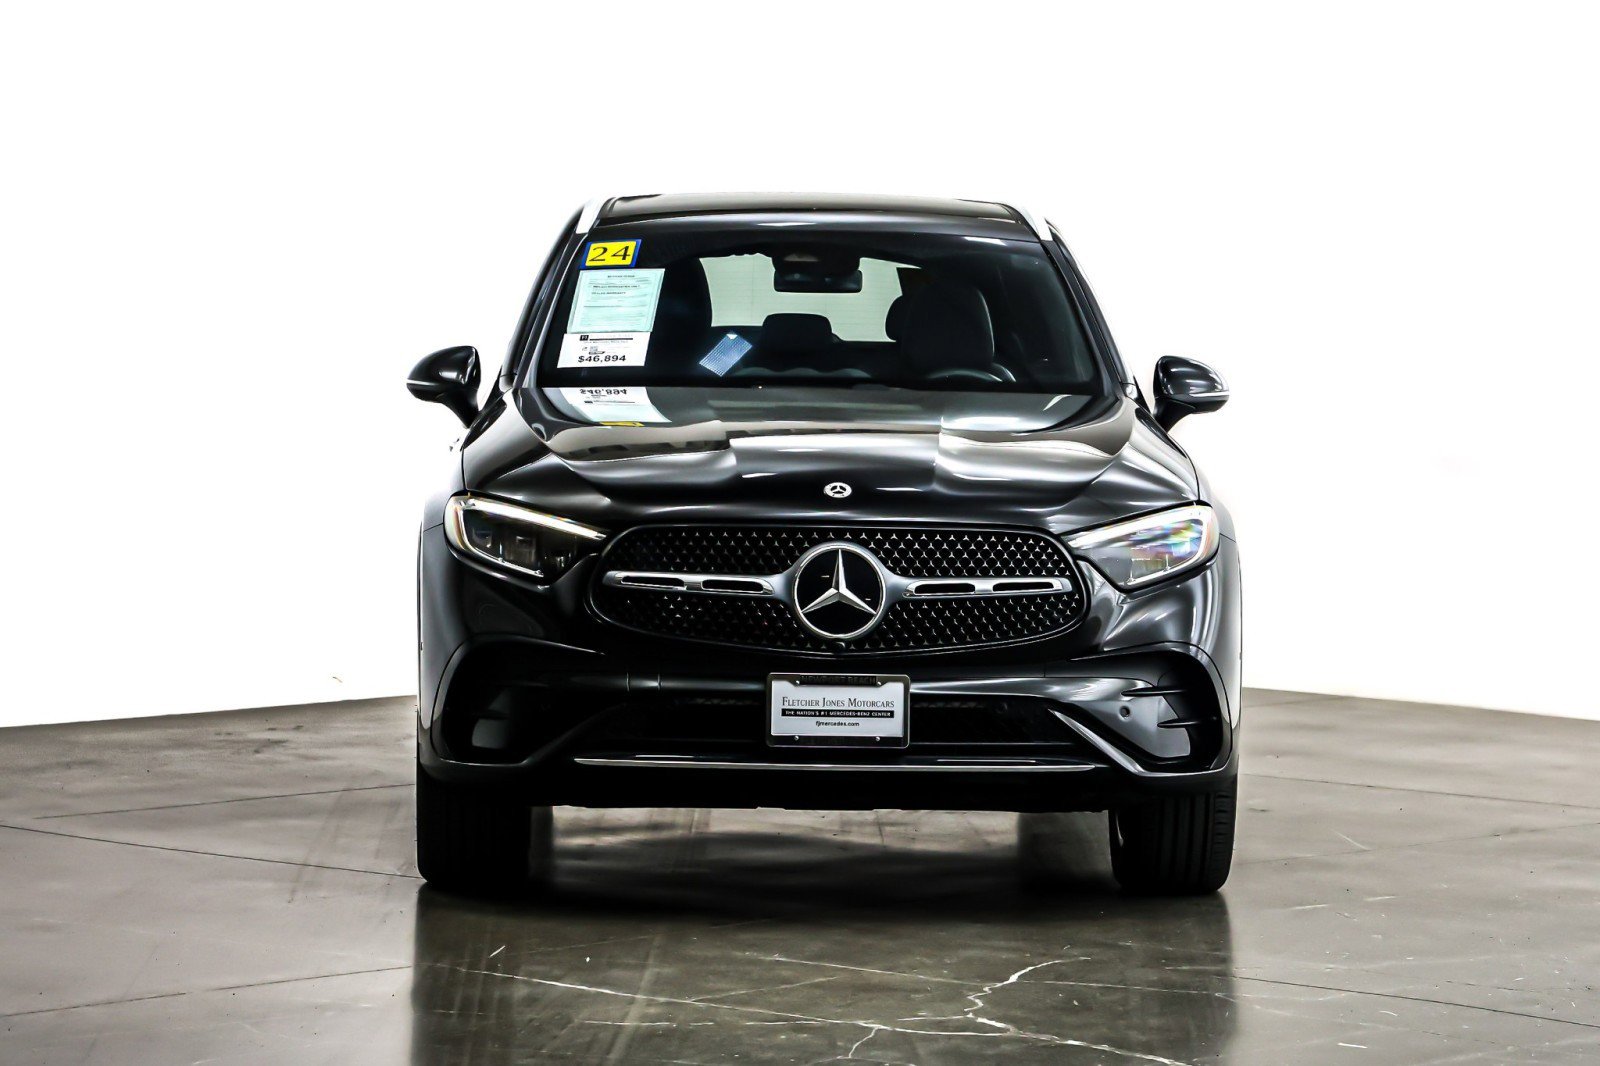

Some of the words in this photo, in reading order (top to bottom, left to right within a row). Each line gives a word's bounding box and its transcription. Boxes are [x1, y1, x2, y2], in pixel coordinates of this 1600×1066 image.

[588, 245, 632, 262] 24
[578, 354, 626, 363] $46,894
[782, 696, 820, 707] FLETCHER
[822, 697, 845, 708] JONES
[847, 697, 895, 708] MOTORCARS
